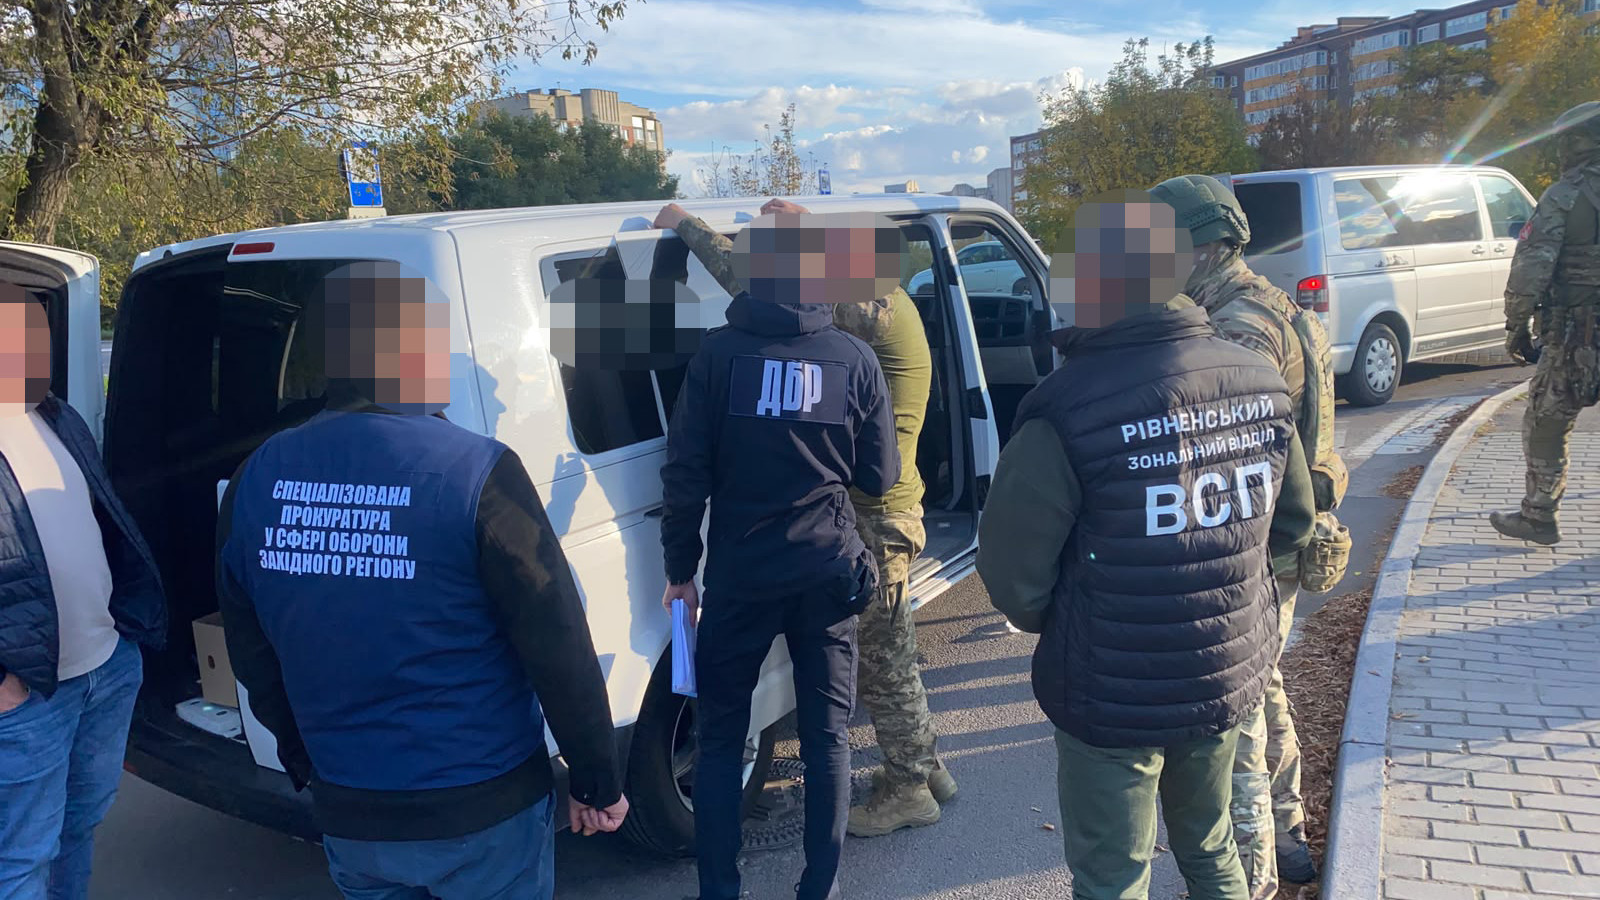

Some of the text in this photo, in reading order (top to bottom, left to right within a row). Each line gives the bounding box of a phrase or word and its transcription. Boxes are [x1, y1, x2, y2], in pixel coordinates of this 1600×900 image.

[756, 359, 822, 416] ДБР
[1120, 395, 1274, 443] РІВНЕНСЬКИЙ
[1128, 428, 1275, 470] ЗОНАЛЬНИЙ ВІДДІЛ
[272, 480, 411, 506] СПЕЦІАЛІЗОВАНА
[1146, 461, 1273, 536] ВСП
[280, 505, 391, 531] ПРОКУРАТУРА
[264, 527, 408, 556] У СФЕРІ ОБОРОНИ
[259, 550, 416, 580] ЗАХІДНОГО РЕГІОНУ
